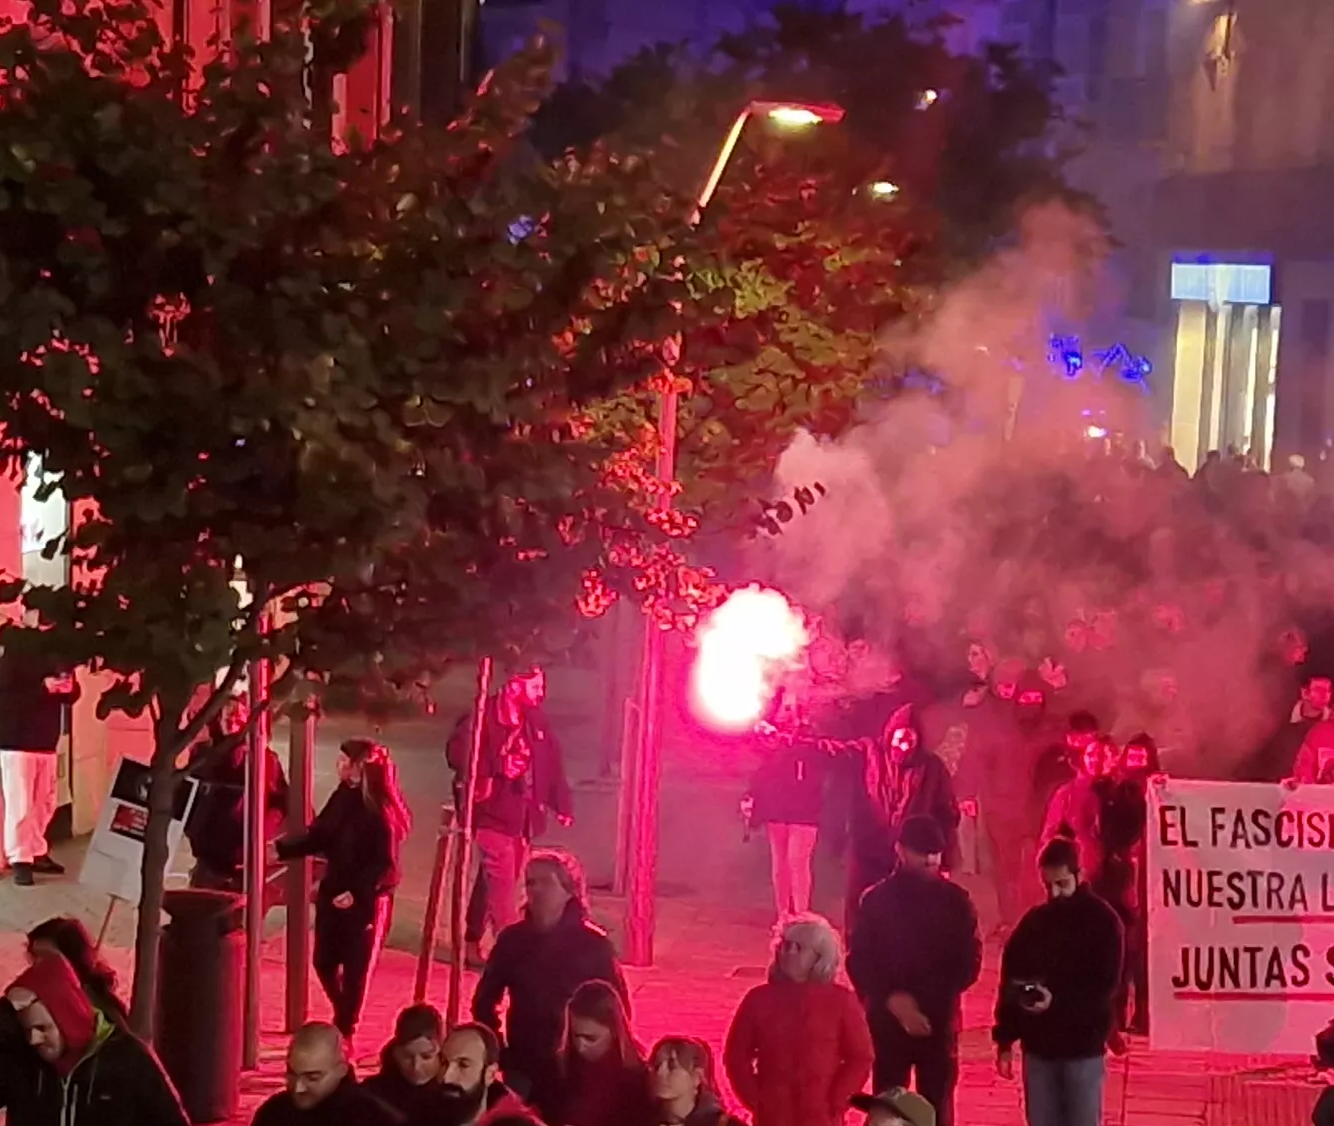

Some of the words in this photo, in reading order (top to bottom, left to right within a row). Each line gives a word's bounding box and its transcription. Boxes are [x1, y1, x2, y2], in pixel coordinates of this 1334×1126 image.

[1159, 805, 1198, 848] EL
[1163, 869, 1309, 912] NUESTRA
[1172, 943, 1311, 990] JUNTAS
